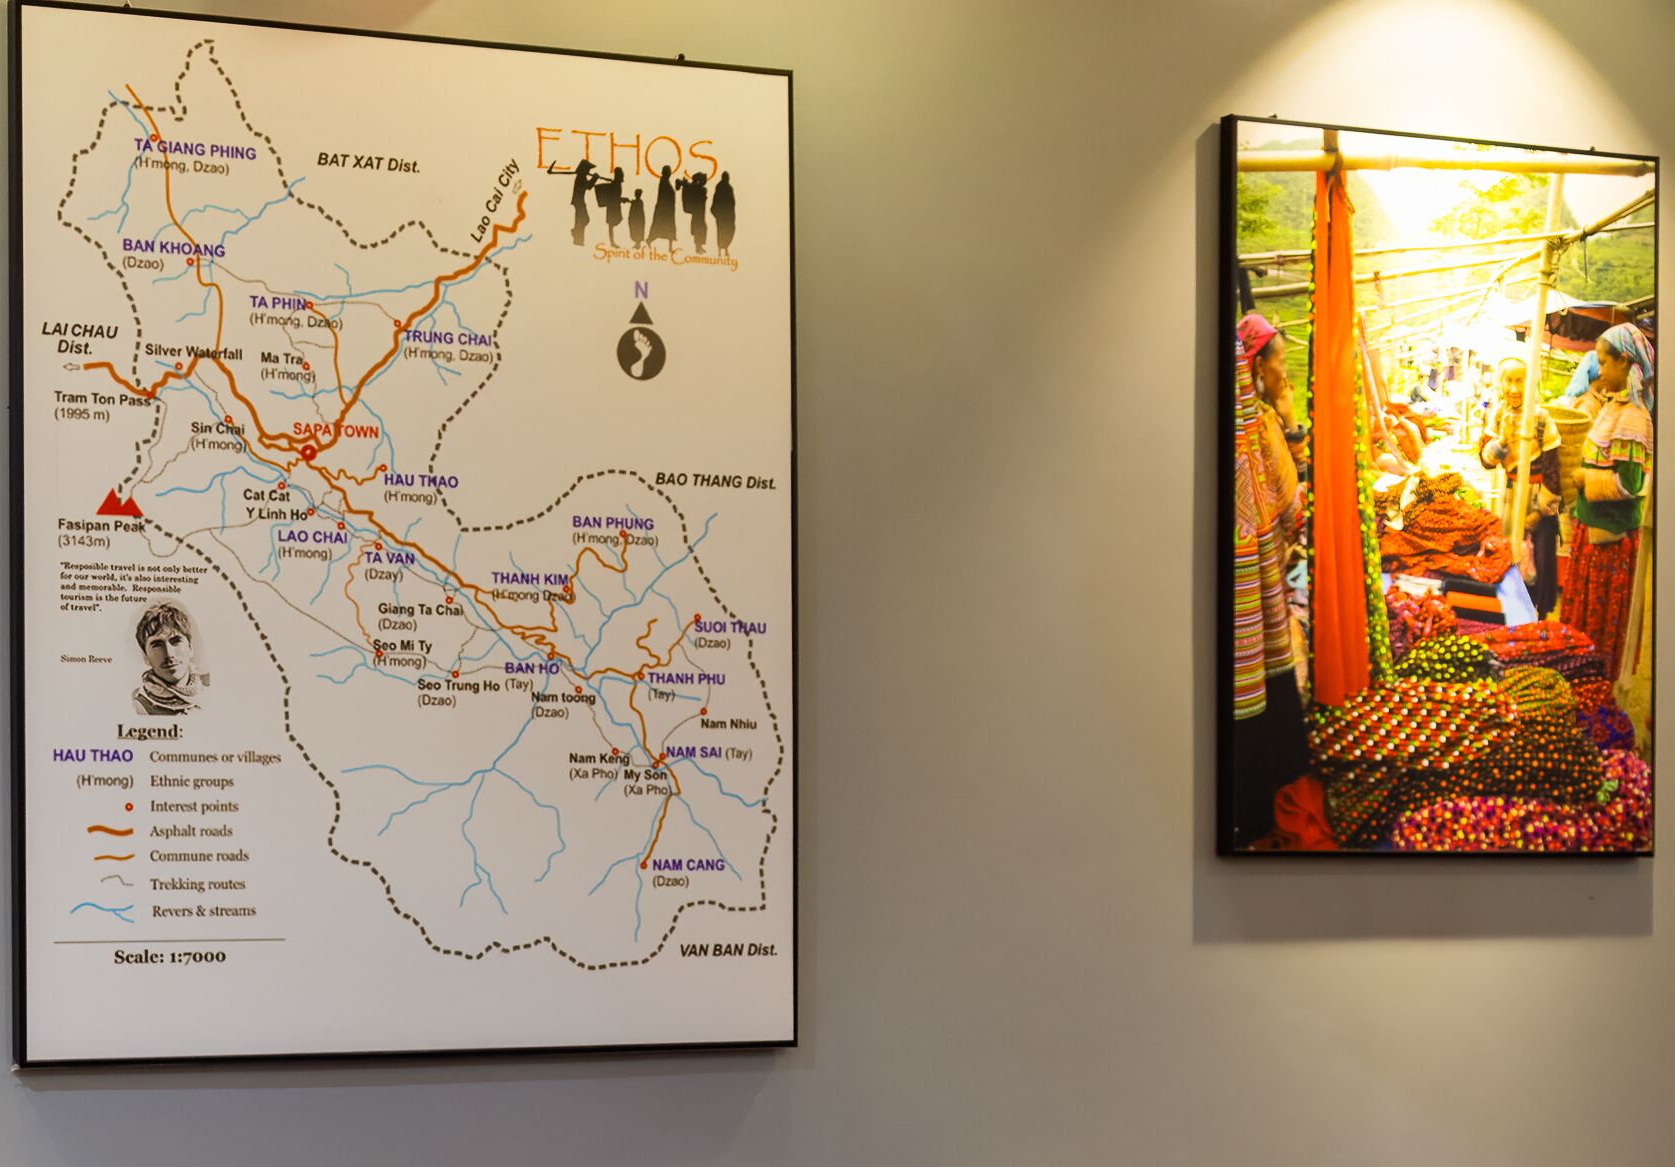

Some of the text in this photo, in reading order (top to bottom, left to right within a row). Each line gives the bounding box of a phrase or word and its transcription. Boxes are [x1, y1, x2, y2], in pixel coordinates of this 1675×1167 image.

[135, 138, 257, 160] TA GIANG PHING
[536, 127, 718, 182] ETHOS
[194, 160, 229, 176] Dzao)
[318, 152, 420, 173] BAT XAT Dist.
[470, 158, 520, 243] Lao Cai City
[123, 238, 225, 258] BAN KHOANG
[122, 256, 164, 271] (Dzao)
[593, 242, 738, 272] Spirit of the Community
[634, 281, 649, 299] N
[250, 295, 268, 308] TA
[41, 321, 118, 339] LAI CHAU
[404, 329, 493, 347] TRUNG CHAI
[57, 339, 92, 355] Dist.
[145, 343, 243, 360] Silver Waterfall
[261, 352, 303, 365] Ma Tra
[459, 349, 494, 364] Dzao)
[54, 391, 151, 407] Tram Ton Pass
[54, 408, 110, 422] (1995 m)
[191, 421, 244, 434] Sin Chai
[293, 422, 332, 436] SAPA
[384, 473, 459, 489] HAU THAO
[656, 472, 777, 490] BAO THANG Dist.
[244, 488, 290, 502] Cat Cat
[246, 507, 308, 521] Y Linh Ho
[58, 518, 145, 533] Fasipan Peak
[573, 516, 654, 530] BAN PHUNG
[58, 535, 111, 549] (3143m)
[278, 530, 347, 544] LAO CHAI
[365, 551, 415, 565] TA VAN
[111, 563, 135, 572] travel
[138, 564, 145, 572] is
[147, 565, 161, 573] not
[163, 565, 180, 574] only
[183, 565, 207, 574] better
[364, 568, 403, 582] (Dzay)
[60, 572, 72, 580] for
[91, 573, 117, 582] world,
[120, 573, 132, 581] it's
[134, 574, 151, 582] also
[153, 575, 199, 584] interesting
[492, 571, 568, 585] THANH KIM
[78, 584, 127, 592] memorable.
[132, 585, 181, 593] Responsible
[105, 594, 119, 602] the
[121, 594, 147, 603] future
[70, 604, 102, 612] travel".
[378, 603, 415, 617] Giang
[418, 604, 432, 615] Ta
[378, 618, 417, 632] (Dzao)
[694, 621, 767, 634] SUOI THAU
[373, 639, 432, 654] Seo Mi Ty
[694, 637, 731, 650] (Dzao)
[60, 655, 113, 663] Simon Reeve
[505, 662, 560, 674] BAN HO
[505, 678, 534, 693] (Tay)
[648, 672, 726, 685] THANH PHU
[418, 679, 500, 694] Seo Trung Ho
[418, 694, 457, 709] (Dzao)
[531, 691, 596, 705] Nam toong
[531, 706, 569, 720] (Dzao)
[701, 718, 757, 730] Nam Nhiu
[117, 724, 184, 740] Legend:
[53, 749, 134, 762] HAU THAO
[150, 751, 282, 766] Communes or villages
[569, 753, 630, 766] Nam Keng
[666, 746, 753, 760] NAM SAI (Tay)
[569, 768, 618, 781] (Xa Pho)
[624, 769, 667, 782] My Son
[150, 775, 234, 790] Ethnic groups
[150, 800, 239, 815] Interest points
[150, 825, 233, 840] Asphalt roads
[150, 849, 250, 862] Commune roads
[652, 859, 725, 871] NAM CANG
[150, 878, 245, 892] Trekking routes
[652, 875, 689, 888] (Dzao)
[153, 905, 256, 917] Revers & streams
[114, 949, 226, 965] Scale: 1:7000
[680, 943, 778, 957] VAN BAN Dist.
